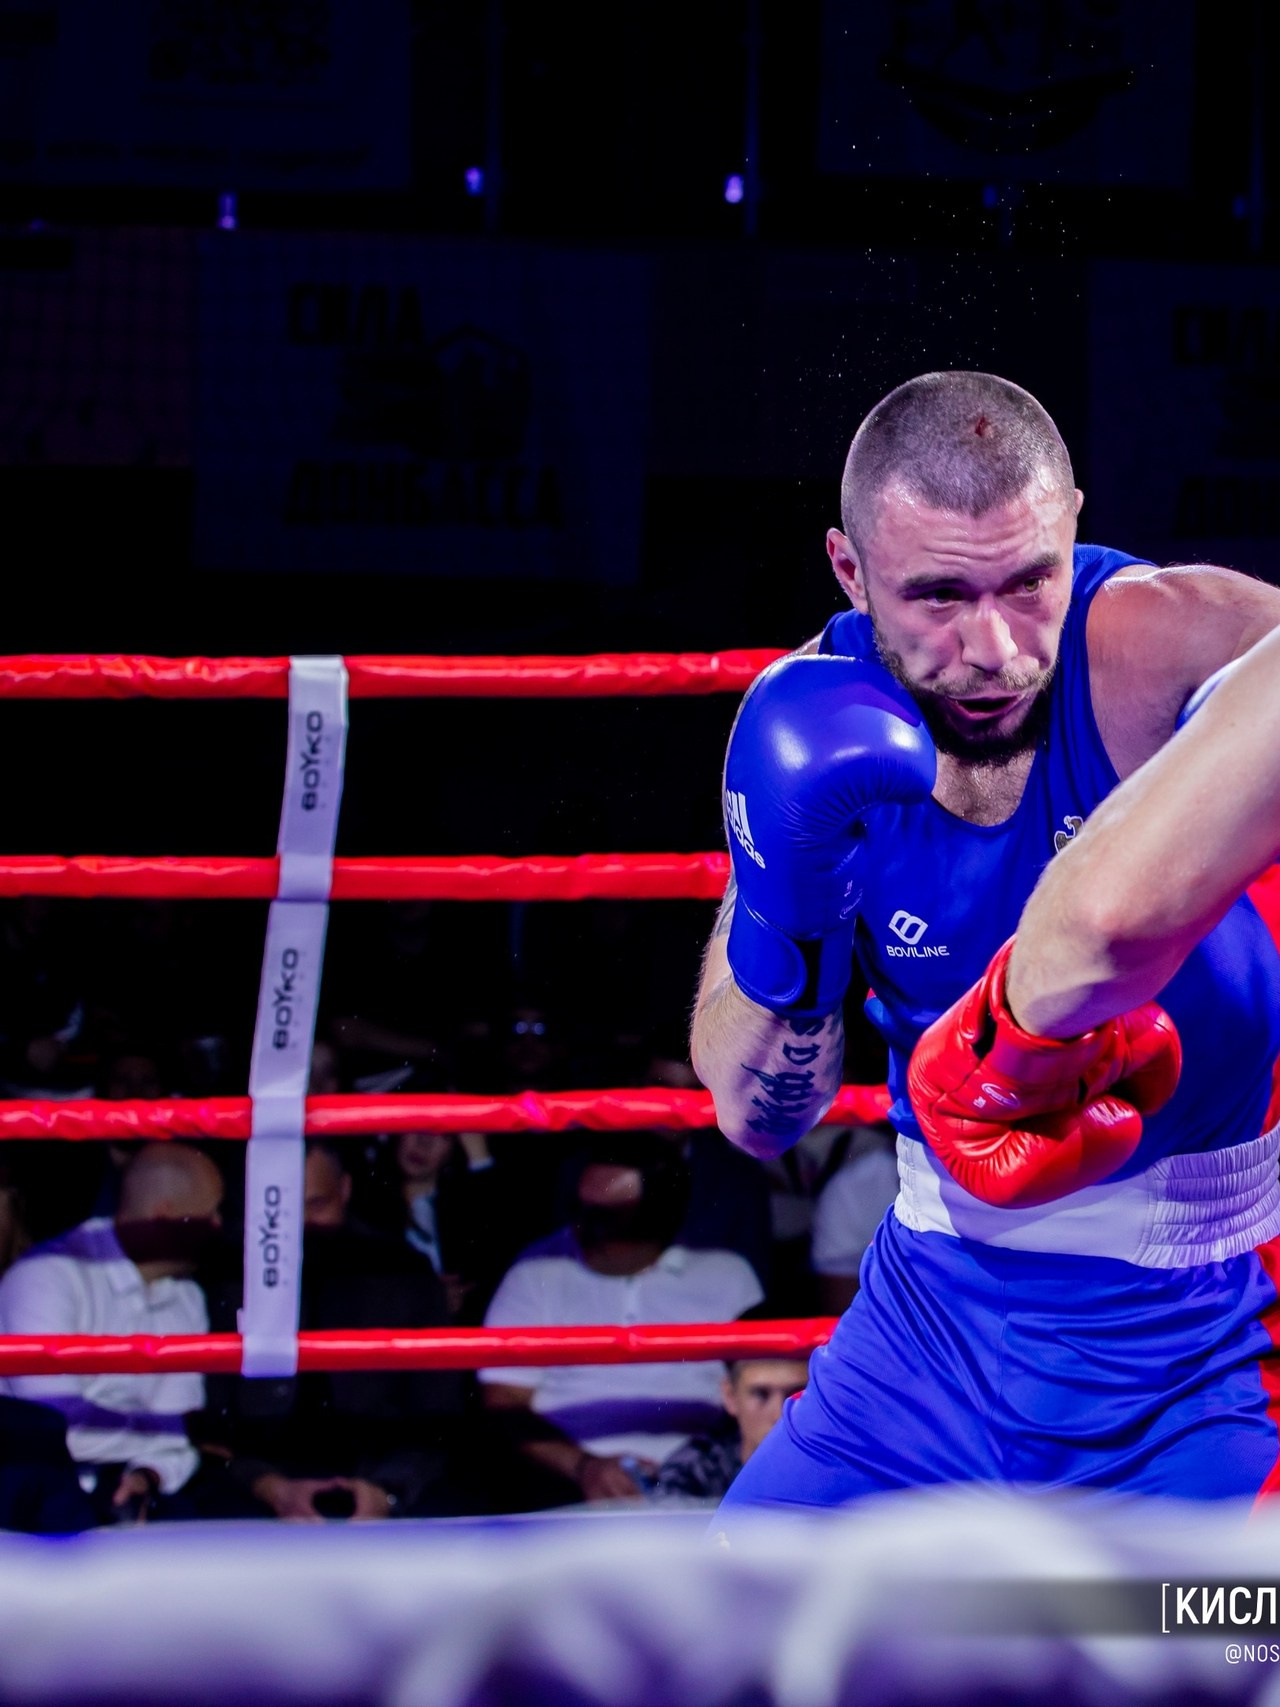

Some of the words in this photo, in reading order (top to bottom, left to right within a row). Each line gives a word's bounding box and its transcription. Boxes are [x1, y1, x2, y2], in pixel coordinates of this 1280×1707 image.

[300, 710, 323, 812] BOYKO
[272, 947, 299, 1051] BOYKO
[886, 944, 950, 958] BOVILINE
[258, 1184, 281, 1289] BOYKO
